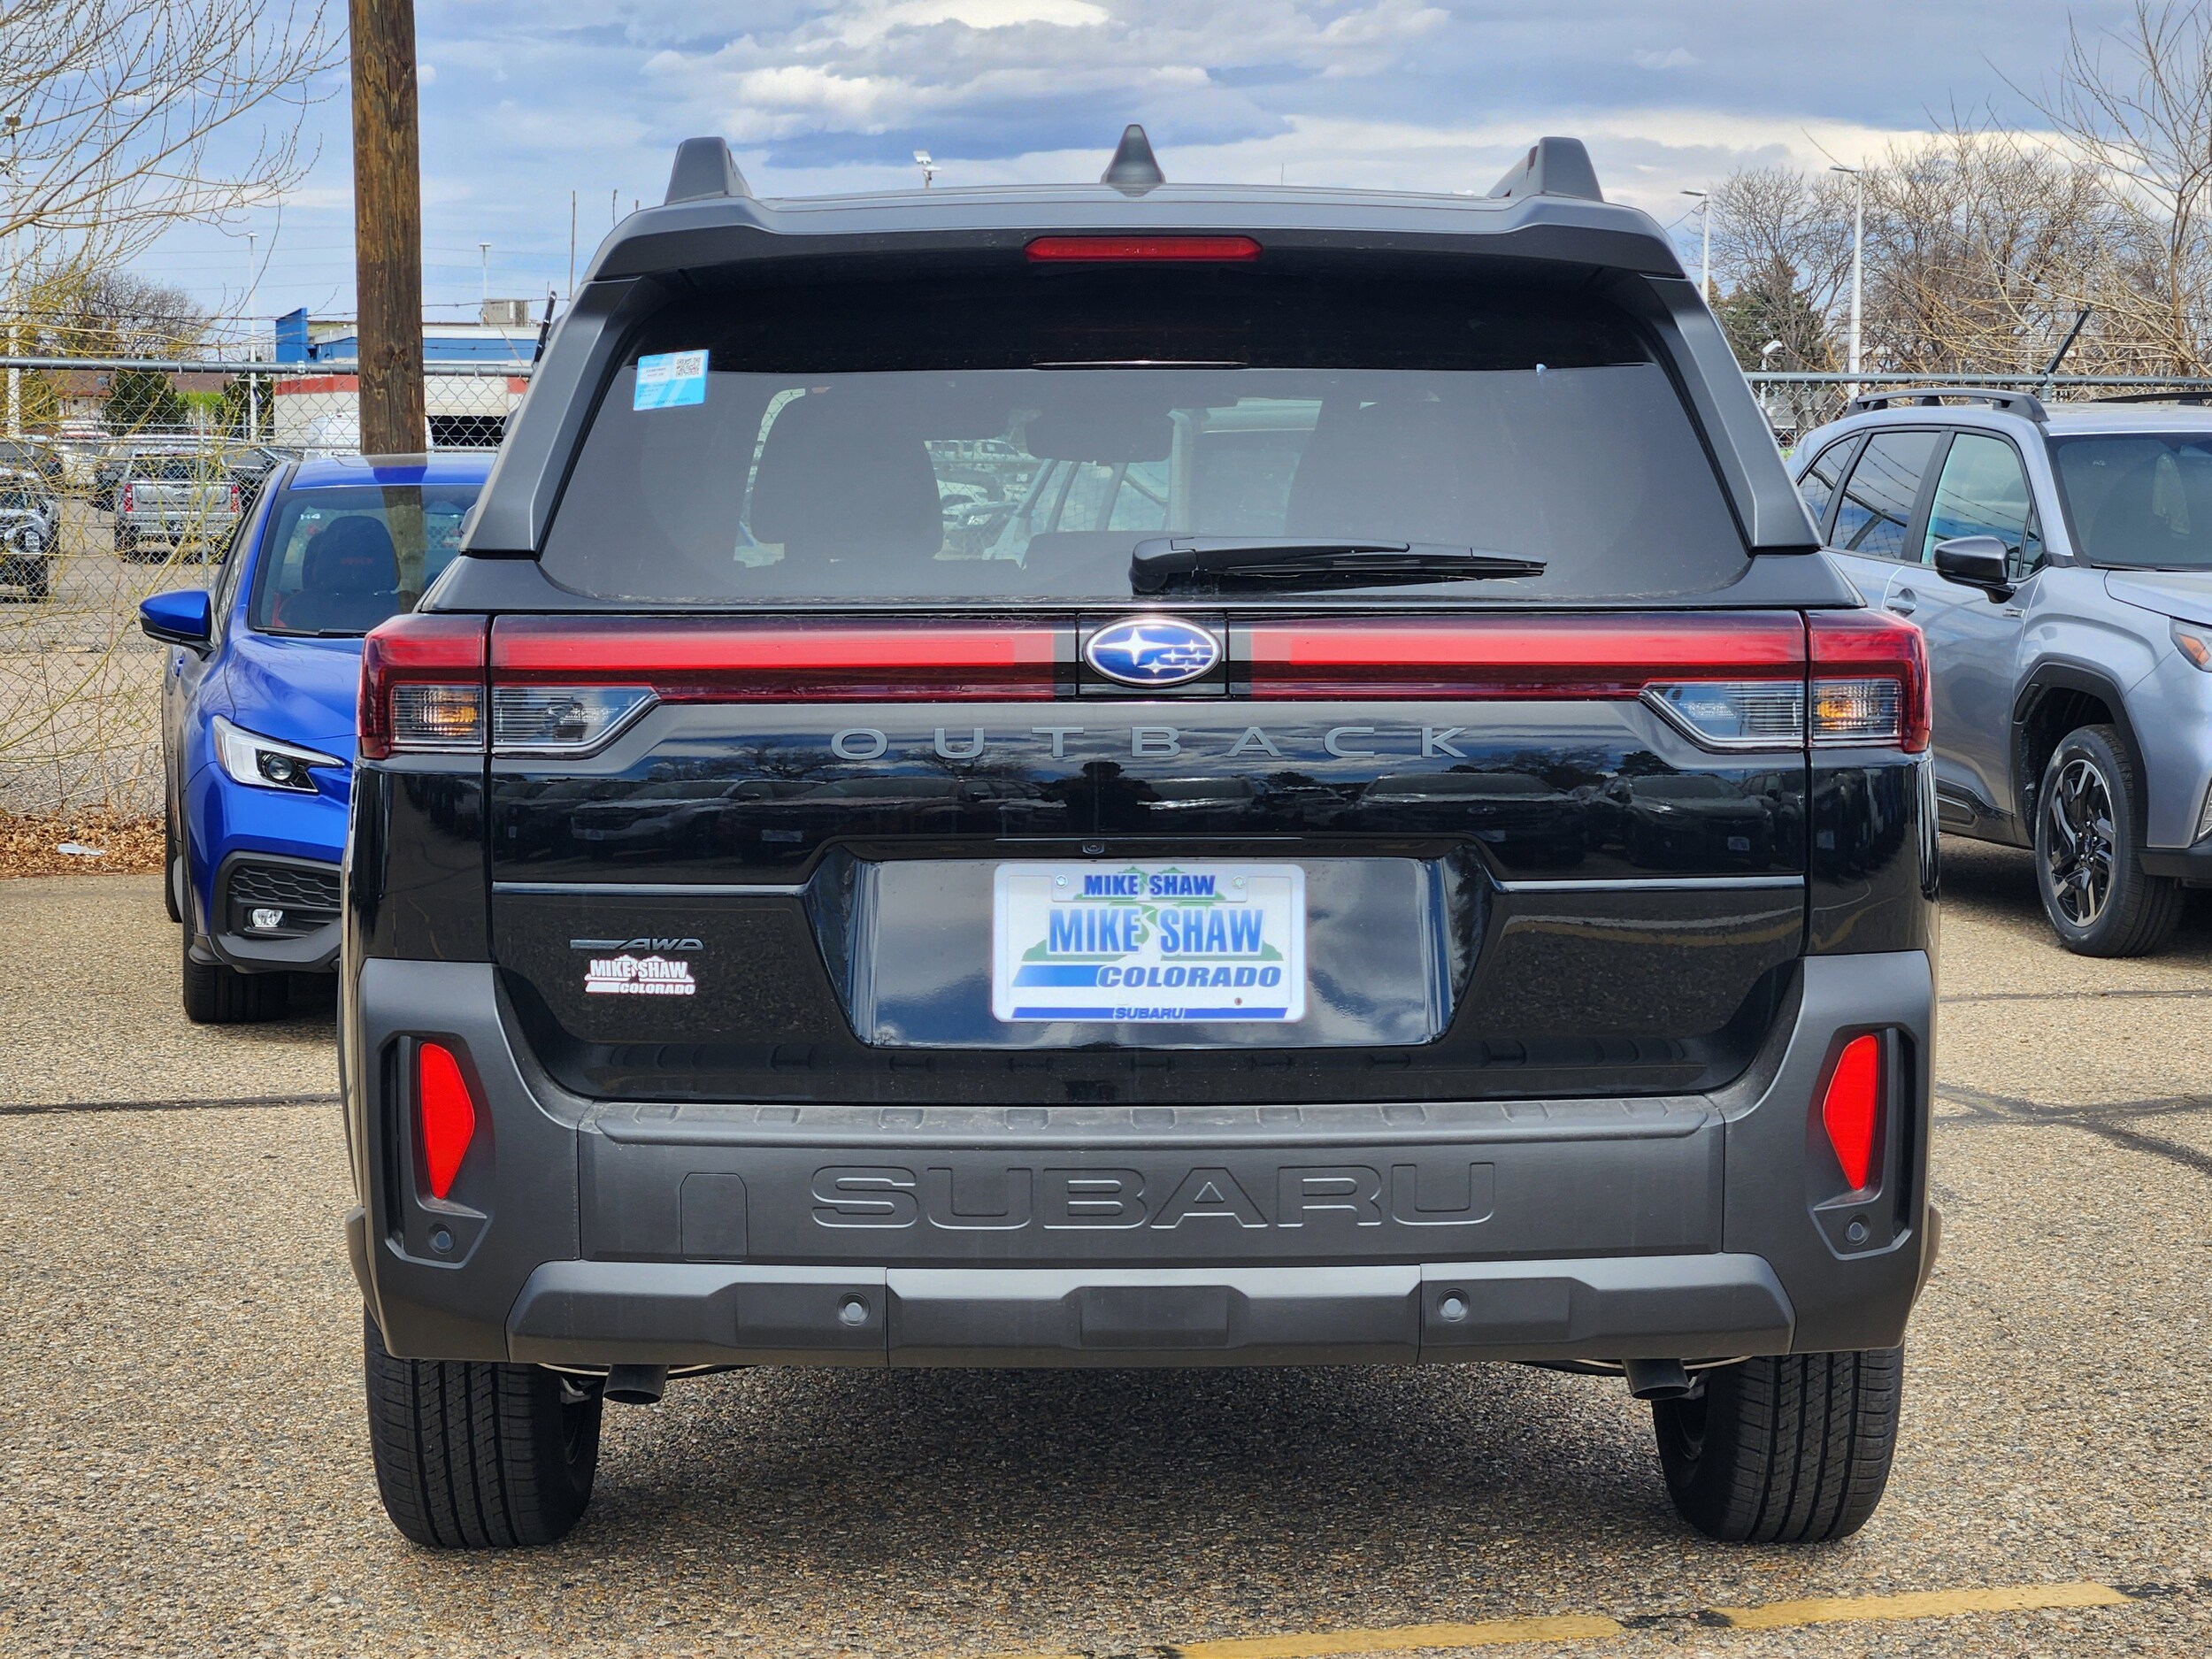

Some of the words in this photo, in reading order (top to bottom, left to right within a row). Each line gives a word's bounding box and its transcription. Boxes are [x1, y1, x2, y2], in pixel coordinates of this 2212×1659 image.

[831, 726, 1468, 760] OUTBACK
[1084, 874, 1140, 896] MIKE
[1149, 874, 1216, 896] SHAW
[1048, 908, 1141, 954] MIKE
[1159, 908, 1264, 955] SHAW
[619, 938, 704, 951] AWD
[590, 960, 632, 977] MIKE
[638, 962, 688, 979] SHAW
[1097, 965, 1282, 988] COLORADO
[619, 983, 696, 995] COLORADO
[1113, 1007, 1185, 1019] SUBARU
[811, 1163, 1495, 1230] SUBARU
